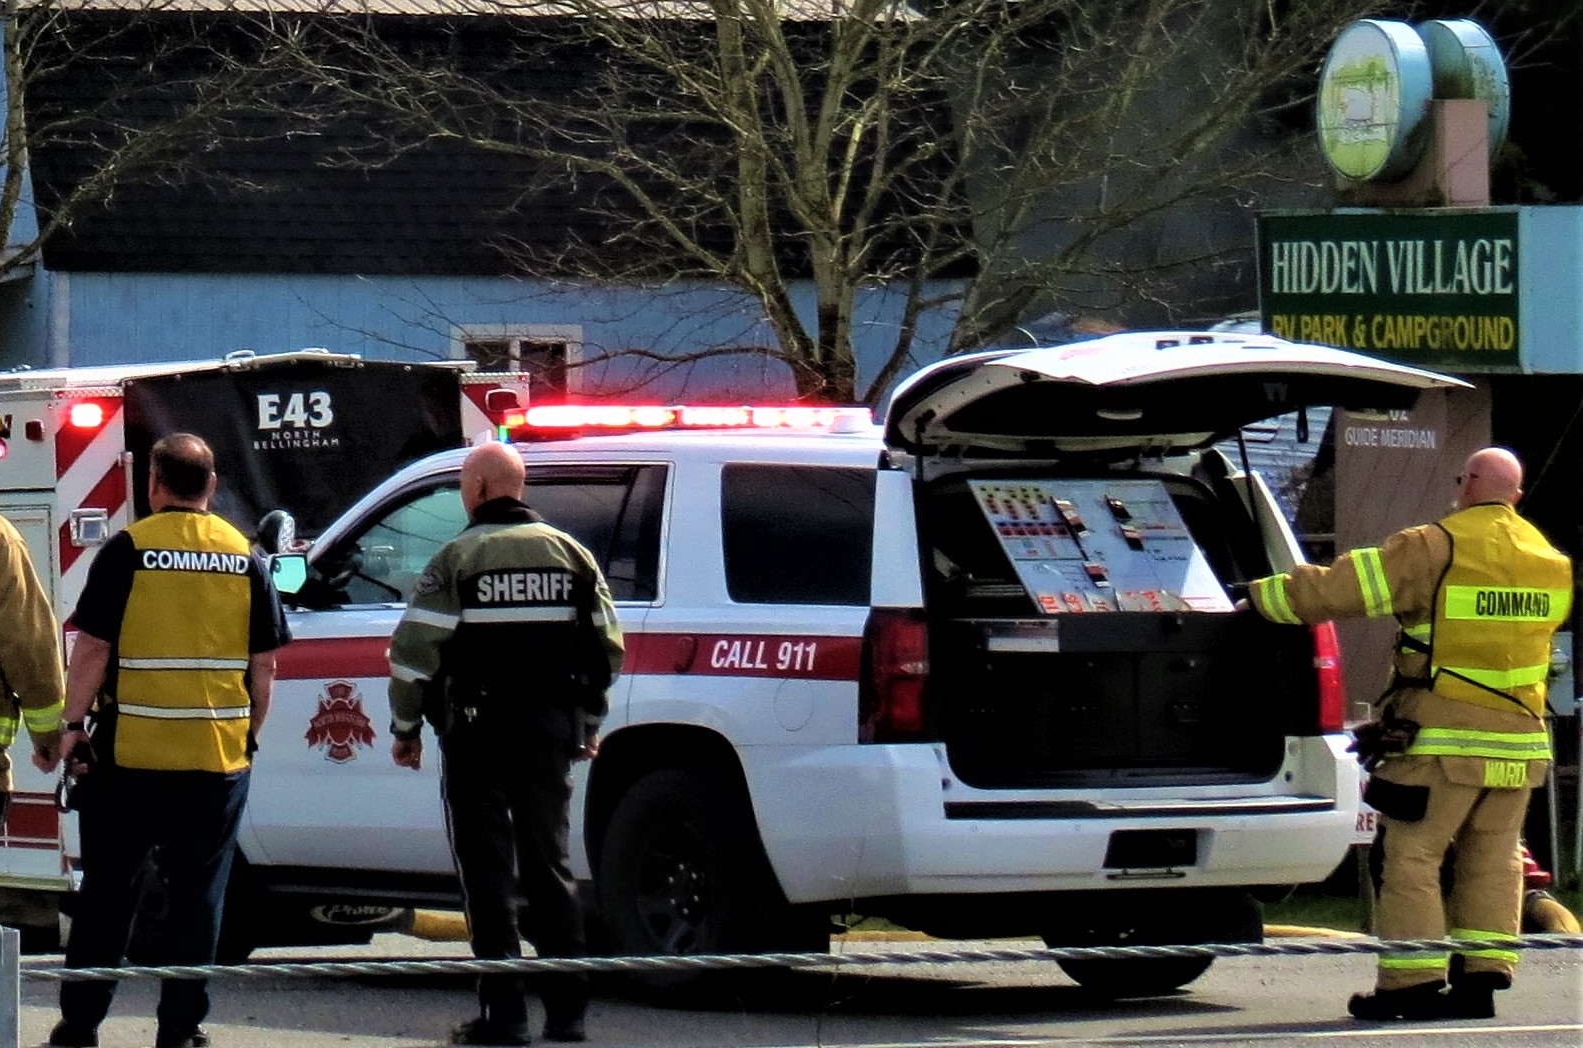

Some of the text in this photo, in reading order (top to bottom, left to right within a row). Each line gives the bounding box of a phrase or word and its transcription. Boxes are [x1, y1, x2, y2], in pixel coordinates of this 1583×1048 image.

[1271, 239, 1513, 295] HIDDEN VILLAGE
[1273, 314, 1515, 350] RV PARK & CAMPGROUND
[257, 391, 334, 430] E43
[253, 438, 339, 450] BELLINGHAM
[271, 431, 321, 440] NORTH
[1345, 426, 1436, 448] GUIDE MERIDIAN
[142, 549, 249, 573] COMMAND
[476, 573, 573, 603] SHERIFF
[1475, 590, 1550, 618] COMMAND
[711, 640, 816, 671] CALL 911
[1486, 761, 1526, 786] WARD
